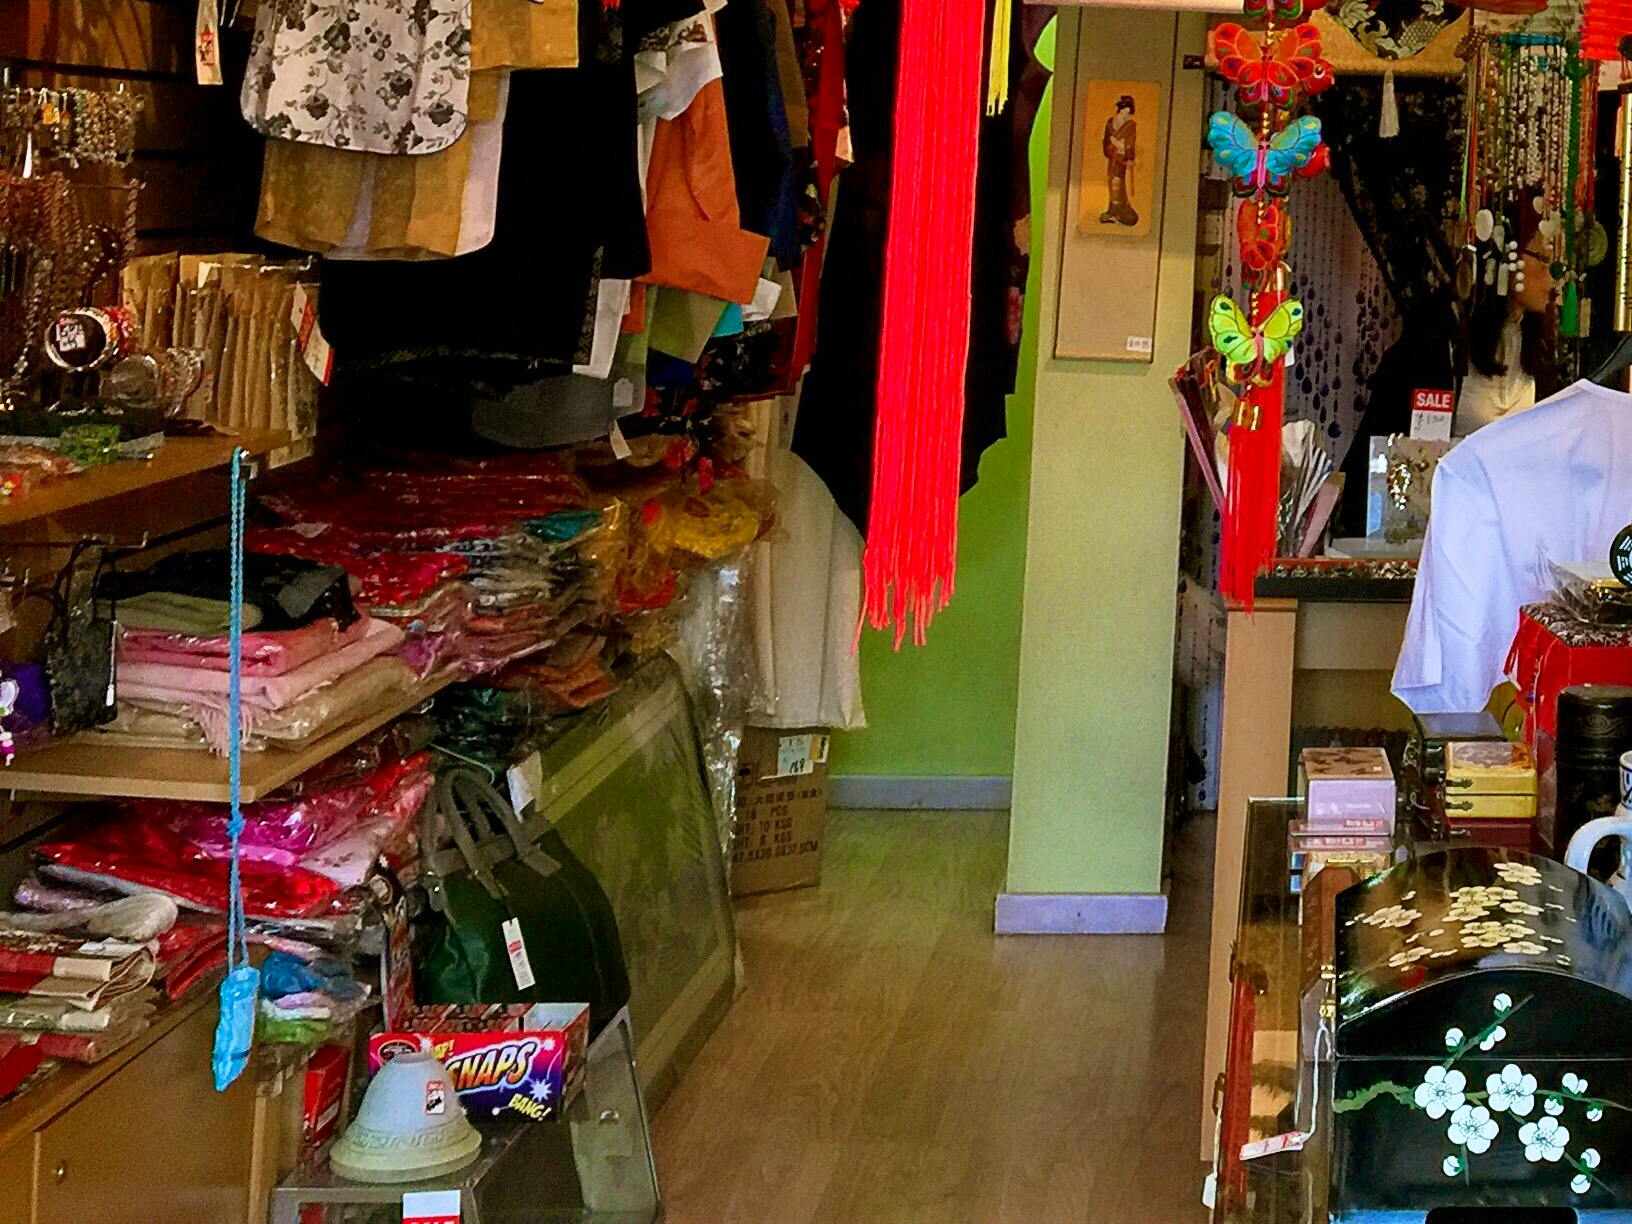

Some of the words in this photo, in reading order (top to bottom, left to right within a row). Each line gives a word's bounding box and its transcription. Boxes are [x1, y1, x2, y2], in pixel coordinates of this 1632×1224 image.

[1416, 392, 1451, 408] SALE
[448, 1041, 537, 1091] SNAPS
[510, 1093, 552, 1122] BANG!
